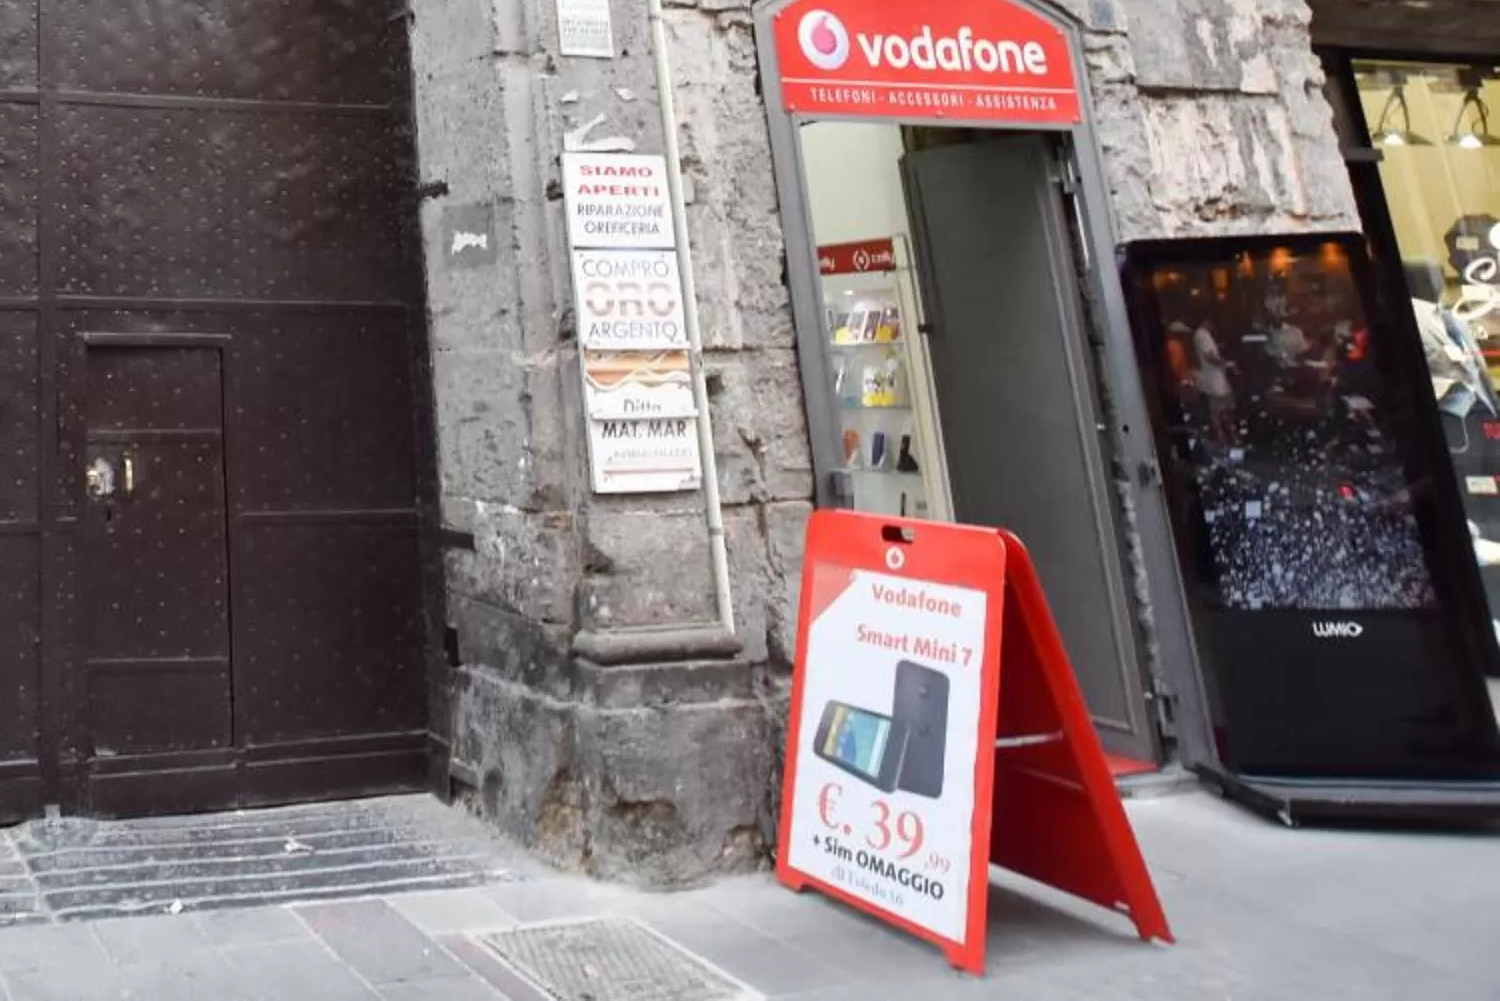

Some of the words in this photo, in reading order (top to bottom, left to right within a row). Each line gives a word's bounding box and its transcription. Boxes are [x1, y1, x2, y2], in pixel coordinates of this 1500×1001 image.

[856, 24, 1047, 76] vodafone
[810, 86, 876, 105] TELEFONI
[889, 92, 964, 108] ACCESSORI
[976, 94, 1057, 111] ASSISTENZA
[580, 165, 653, 177] SIAMO
[578, 184, 659, 197] APERTI
[577, 202, 664, 217] RIPARAZIONE
[584, 220, 660, 235] OREFICERIA
[582, 259, 669, 278] COMPRO
[588, 321, 678, 340] ARGENTO
[647, 420, 687, 439] MAR
[871, 583, 962, 618] Vodafone
[856, 623, 909, 652] Smart
[913, 635, 957, 664] Mini
[961, 647, 973, 667] 7
[823, 835, 853, 862] Sim
[855, 850, 945, 901] OMAGGIO
